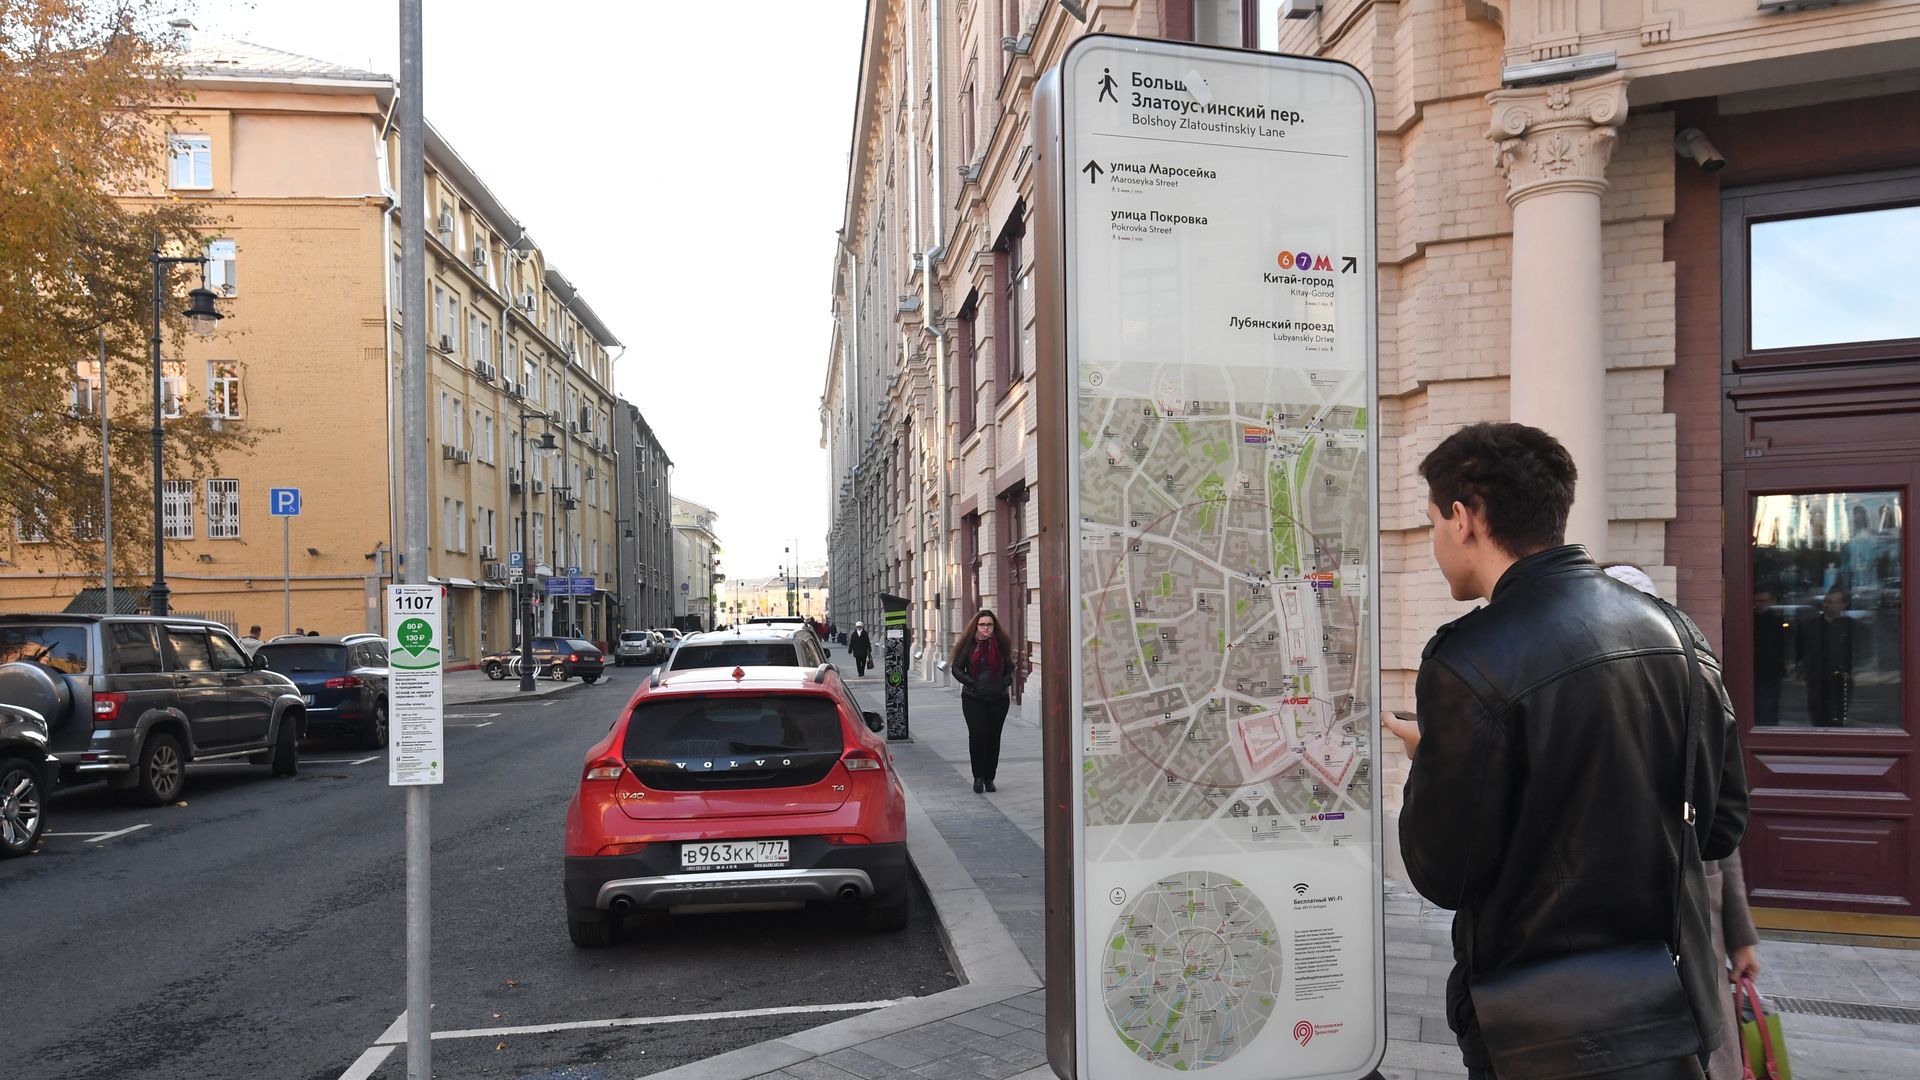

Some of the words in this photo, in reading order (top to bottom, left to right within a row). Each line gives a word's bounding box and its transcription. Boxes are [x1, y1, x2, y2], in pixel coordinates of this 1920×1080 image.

[1132, 71, 1208, 92] Больш
[1270, 109, 1304, 125] пер.
[1132, 113, 1177, 130] Bolshoy
[1179, 117, 1256, 138] Zlatoustinskiy
[1259, 125, 1286, 138] Lane
[1110, 162, 1146, 174] улица
[1149, 163, 1217, 179] Маросейка
[1110, 175, 1154, 186] Maroseyka
[1155, 178, 1178, 187] Street
[1111, 210, 1147, 221] улица
[1150, 210, 1208, 225] Покровка
[1111, 222, 1147, 233] Pokrovka
[1149, 225, 1172, 234] Street
[1263, 272, 1335, 288] Китай-город
[1290, 288, 1335, 298] Kitay-Gorod
[1229, 316, 1291, 330] Лубянский
[1294, 321, 1335, 333] проезд
[1273, 333, 1314, 343] Lubyanskiy
[1315, 335, 1335, 343] Drive
[278, 491, 295, 513] P
[511, 553, 521, 565] P
[395, 596, 434, 610] 1107
[676, 758, 791, 770] VOLVO
[832, 784, 844, 792] T4
[758, 842, 784, 856] 777
[1293, 897, 1327, 905] Бесплатный
